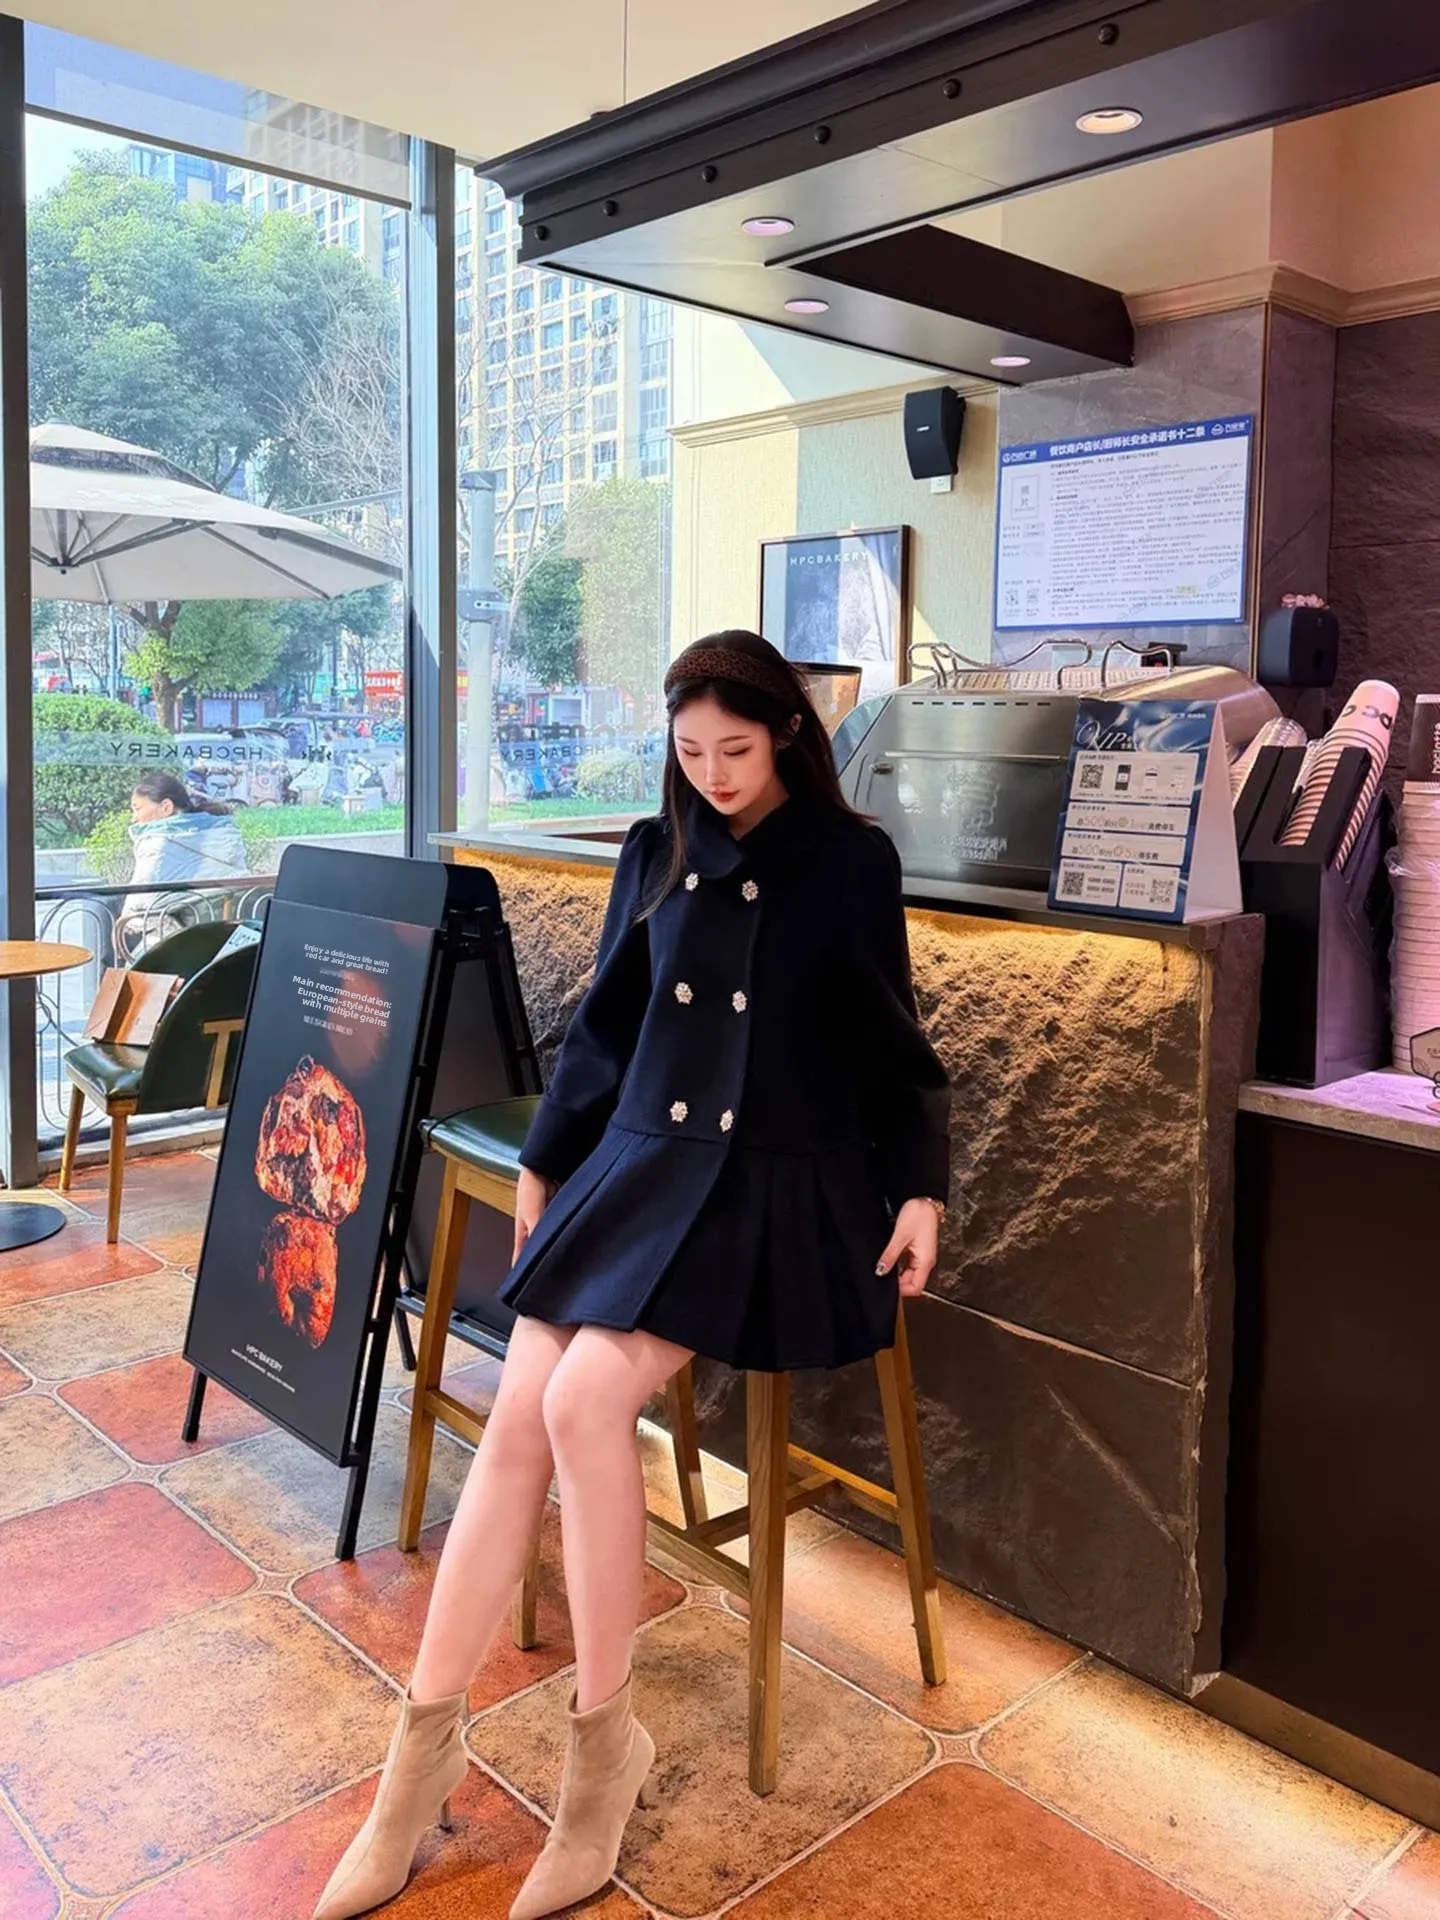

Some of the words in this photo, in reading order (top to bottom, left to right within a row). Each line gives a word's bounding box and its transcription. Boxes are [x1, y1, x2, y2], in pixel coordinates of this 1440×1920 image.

[790, 551, 868, 566] HPCBAKERY
[304, 943, 324, 955] Enjoy
[330, 949, 361, 962] delicious
[362, 956, 373, 964] life
[373, 958, 390, 968] with
[305, 951, 318, 960] red
[318, 954, 330, 962] car
[331, 955, 344, 966] and
[345, 960, 364, 971] great
[365, 964, 389, 975] bread!
[292, 975, 315, 988] Main
[315, 982, 392, 1009] recommendation:
[297, 987, 363, 1011] European-style
[364, 1005, 391, 1019] bread
[302, 998, 322, 1010] with
[323, 1003, 359, 1019] multiple
[360, 1013, 388, 1028] grains
